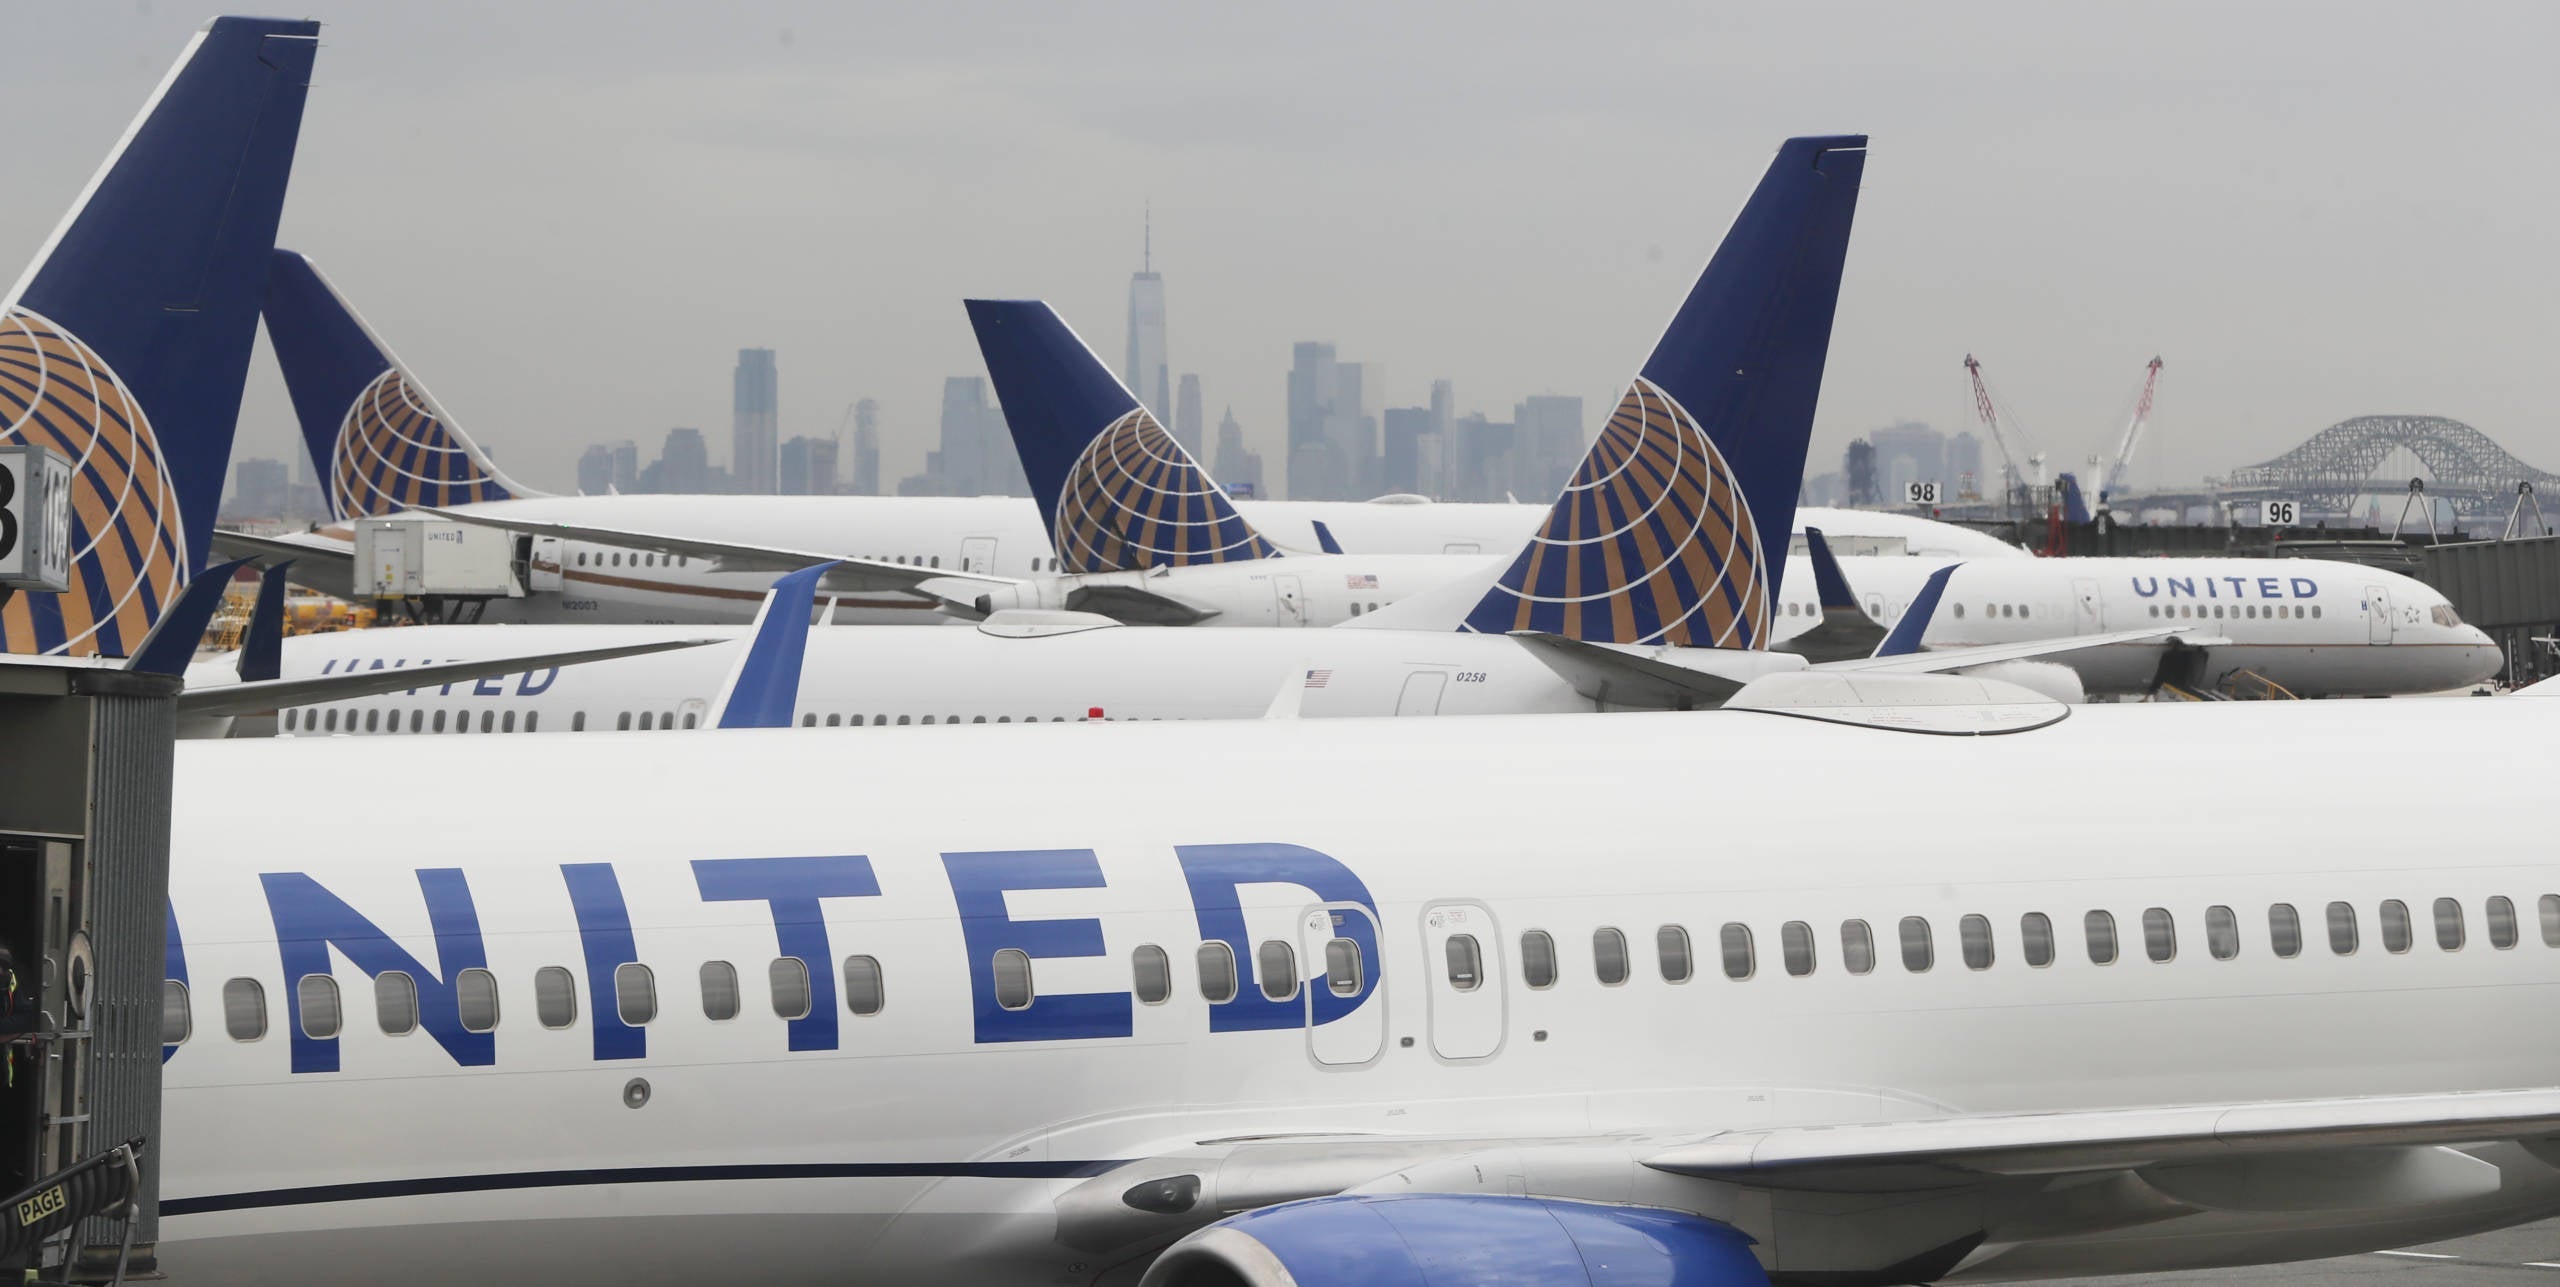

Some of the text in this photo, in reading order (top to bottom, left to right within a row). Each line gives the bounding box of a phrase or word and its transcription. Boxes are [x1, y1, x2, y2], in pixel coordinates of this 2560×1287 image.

[1910, 483, 1935, 501] 98
[42, 466, 70, 574] 103
[2269, 502, 2293, 523] 96
[428, 532, 455, 542] UNITED
[2132, 576, 2319, 599] UNITED
[1456, 671, 1487, 682] 0258
[161, 842, 1381, 1074] NITED
[21, 1188, 63, 1222] PAGE
